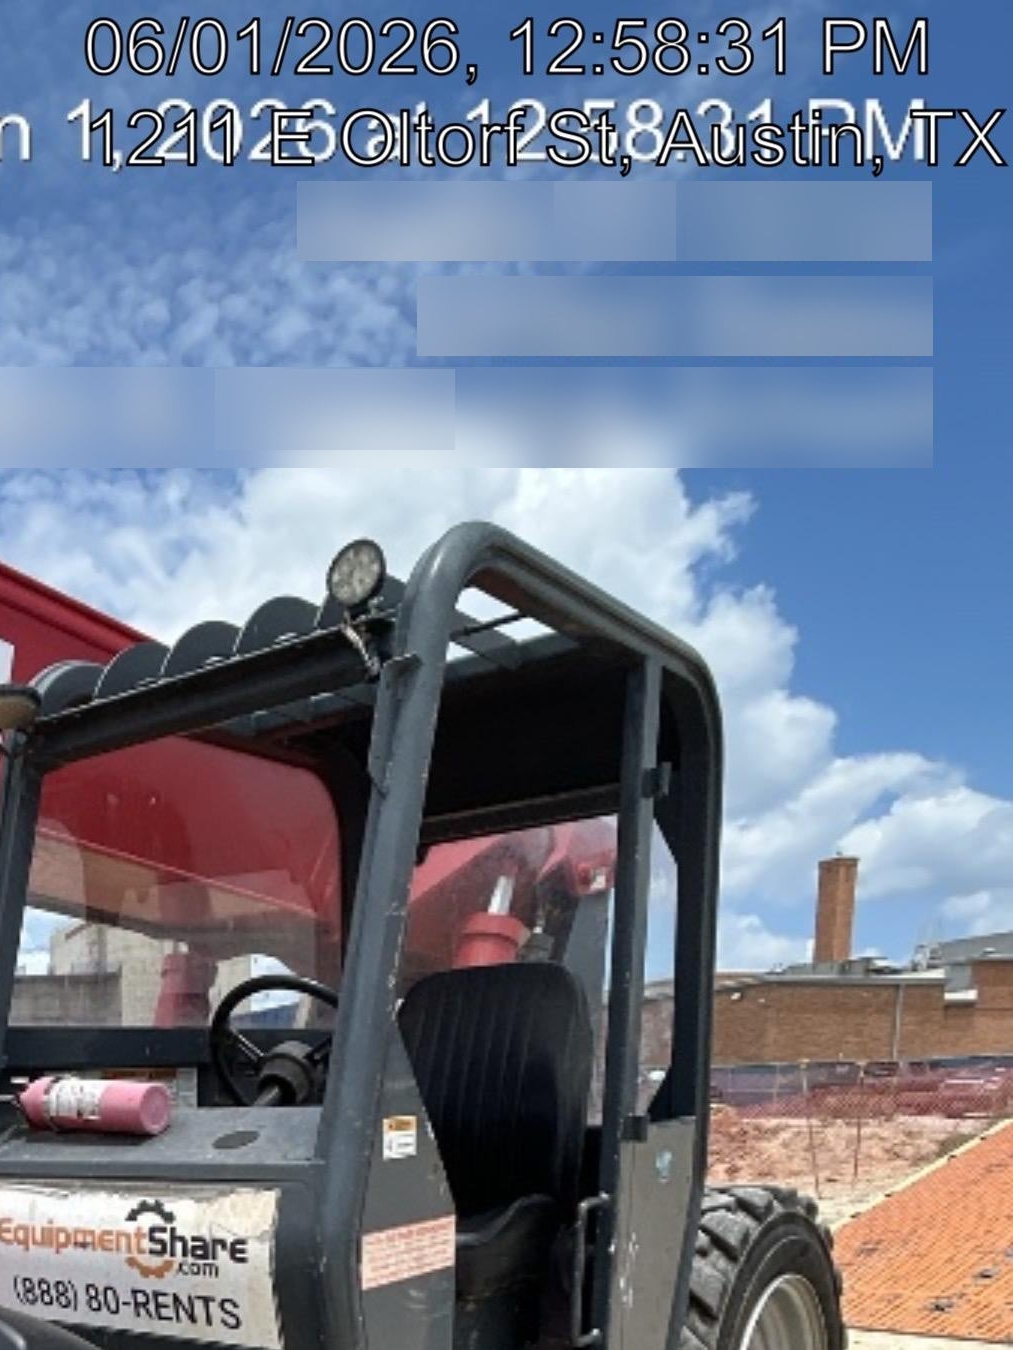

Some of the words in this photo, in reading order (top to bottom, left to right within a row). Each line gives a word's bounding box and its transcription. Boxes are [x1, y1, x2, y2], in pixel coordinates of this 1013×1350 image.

[178, 1259, 220, 1279] .com
[13, 1274, 79, 1312] (888)
[85, 1283, 243, 1330] 80-RENTS
